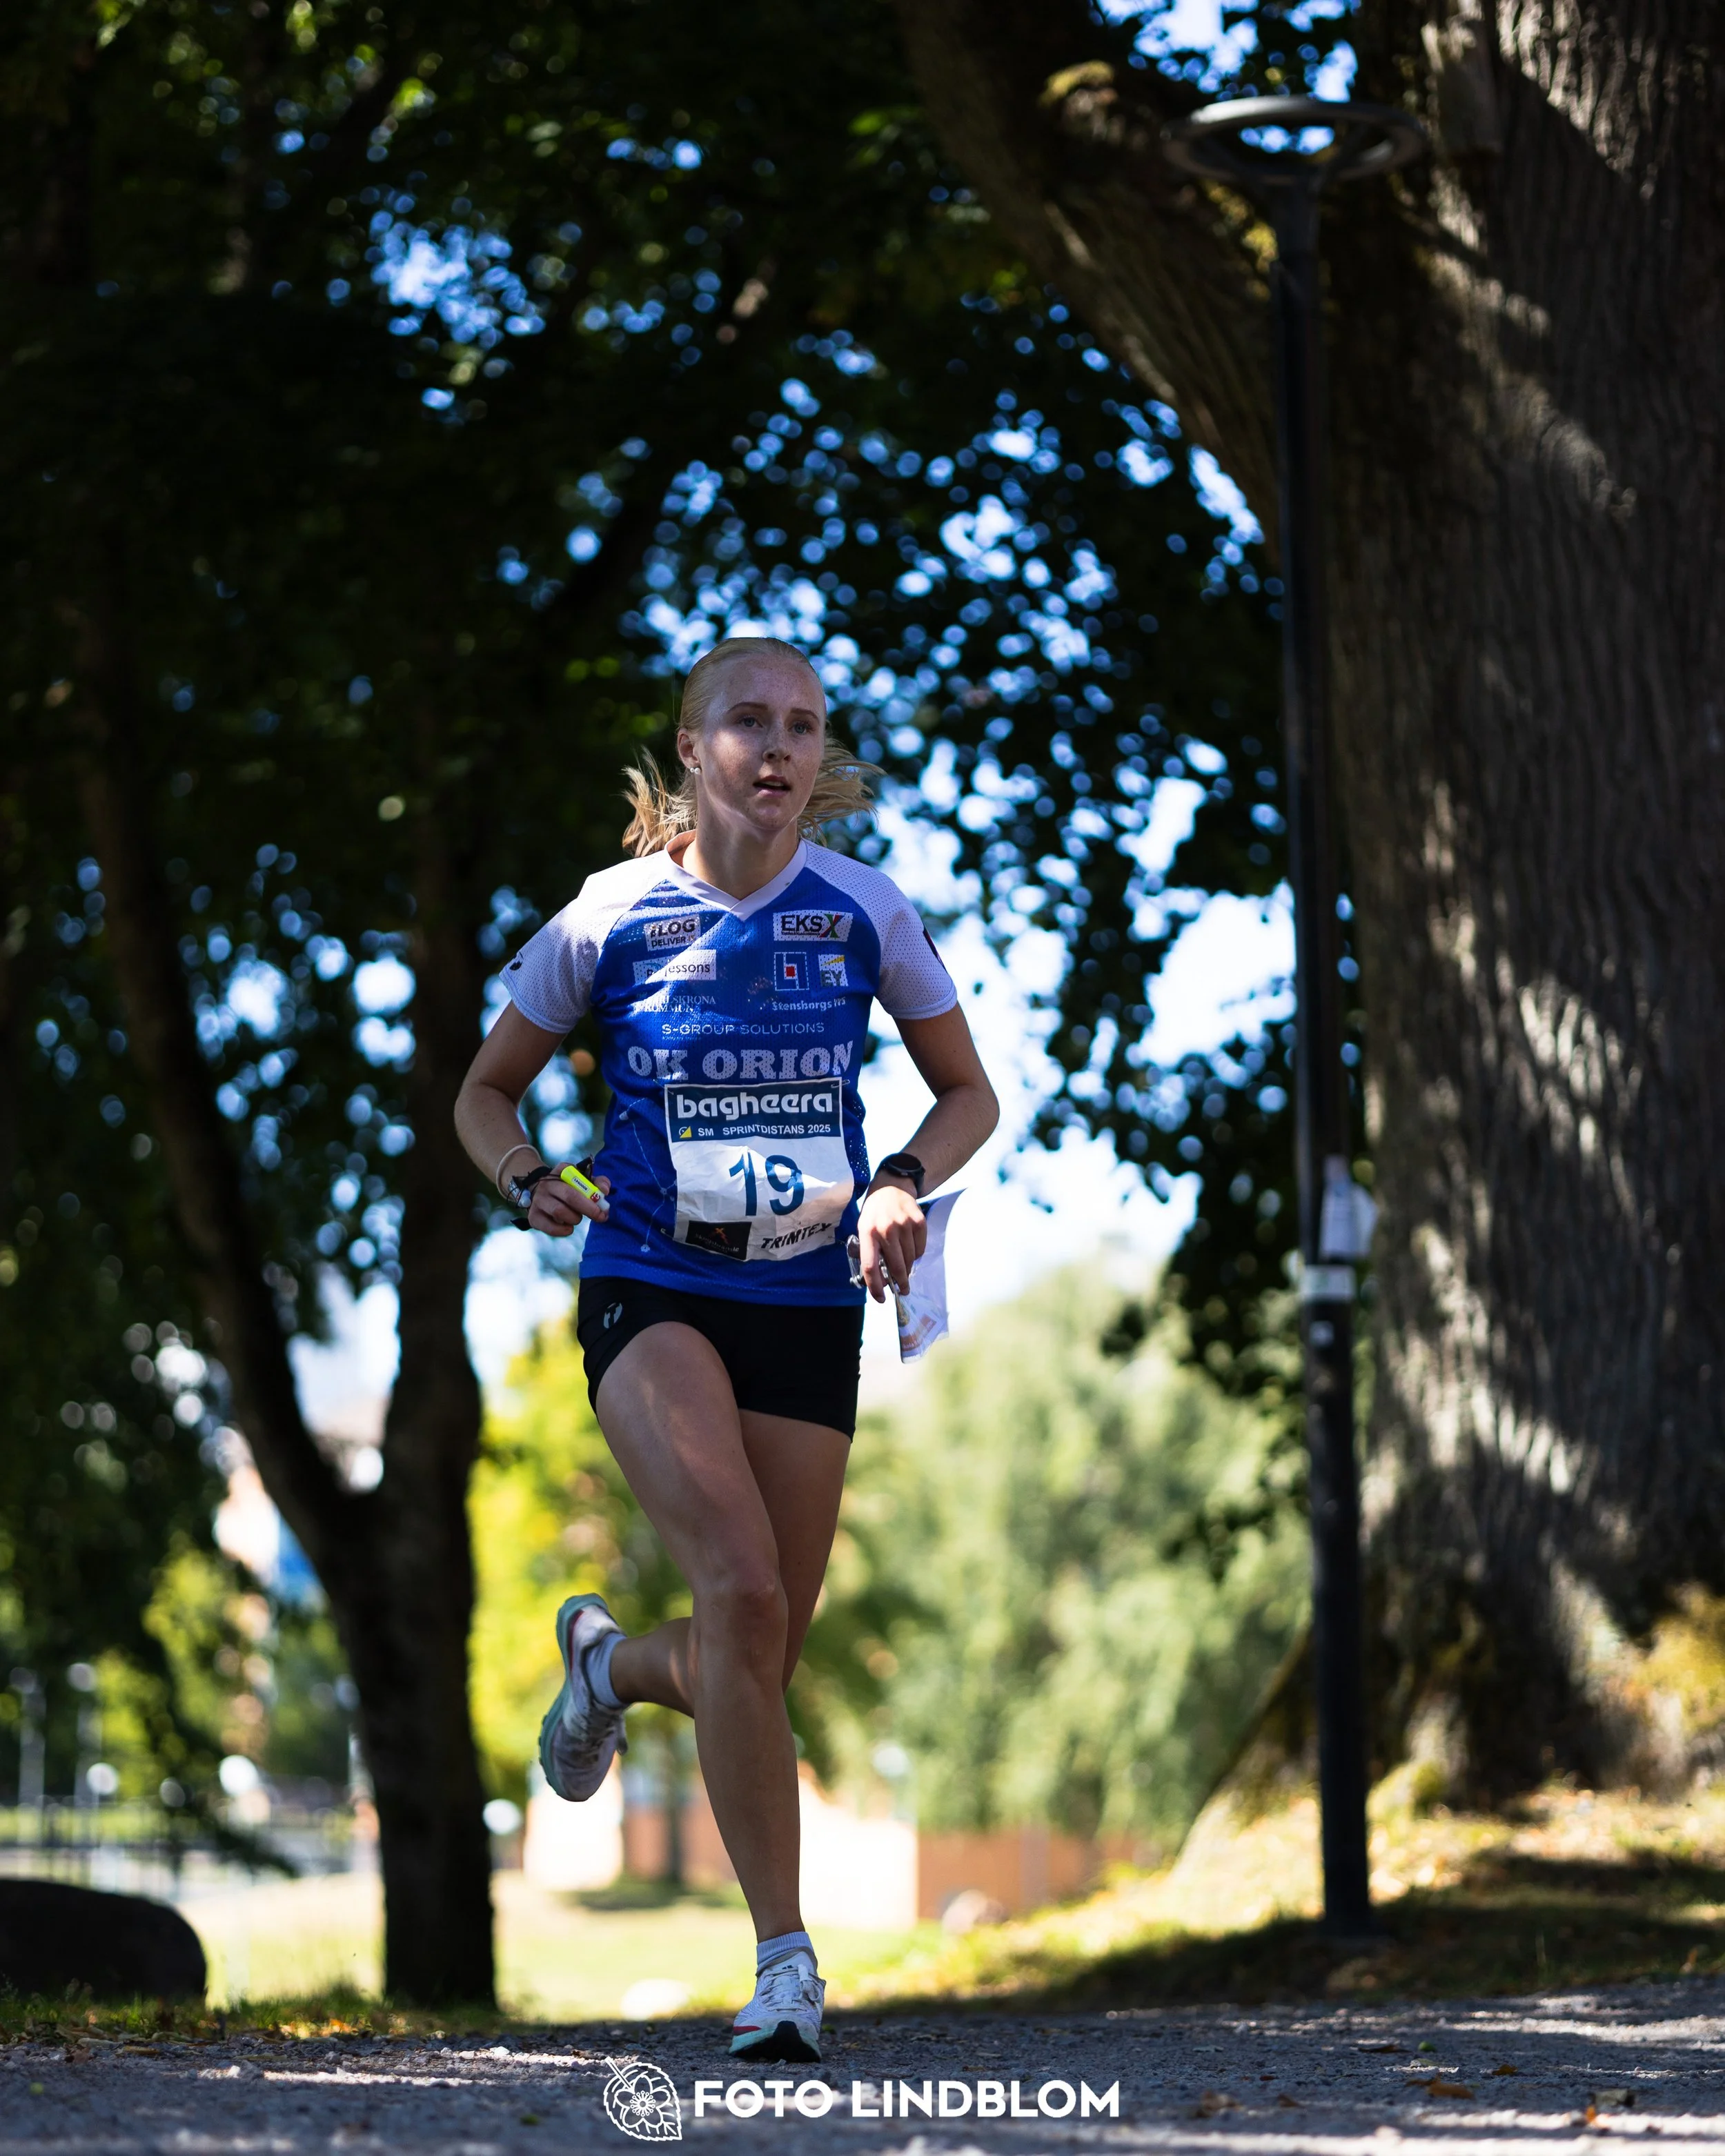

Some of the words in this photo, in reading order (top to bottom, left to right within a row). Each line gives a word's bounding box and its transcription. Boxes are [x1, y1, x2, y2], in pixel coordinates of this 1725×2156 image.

[651, 937, 686, 948] DELIVER
[821, 970, 842, 986] EY
[662, 1024, 734, 1034] S-GROUP
[740, 1022, 825, 1034] SOLUTIONS
[628, 1046, 689, 1080] OK
[702, 1040, 853, 1079] ORION
[678, 1092, 833, 1120] bagheera
[698, 1127, 713, 1136] SM
[723, 1125, 805, 1136] SPRINTDISTANS
[808, 1125, 831, 1134] 2025
[729, 1151, 805, 1216] 19
[761, 1223, 832, 1249] TRIMTEX
